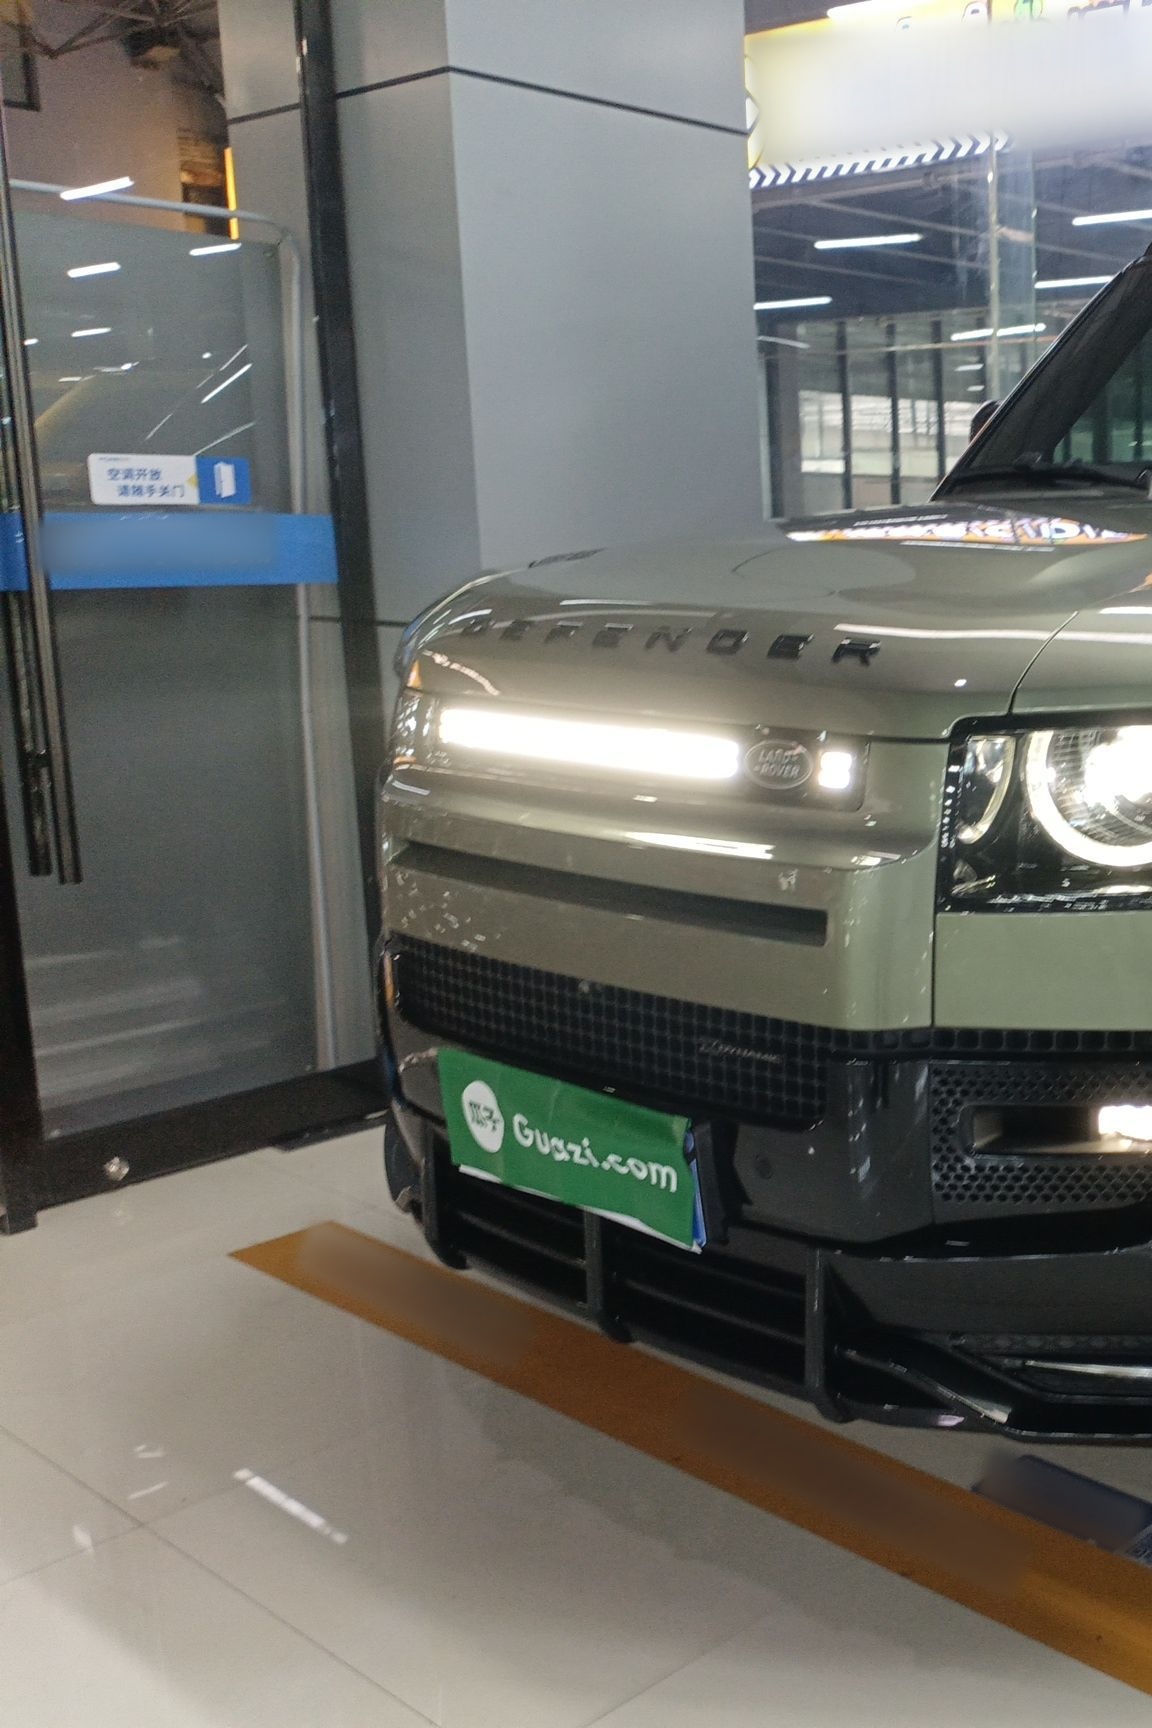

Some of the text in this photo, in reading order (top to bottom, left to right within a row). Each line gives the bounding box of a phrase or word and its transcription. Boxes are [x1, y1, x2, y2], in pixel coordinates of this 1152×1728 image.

[461, 617, 881, 668] DEFENDER
[760, 763, 801, 779] ROVER
[512, 1112, 679, 1194] Guazi.com
